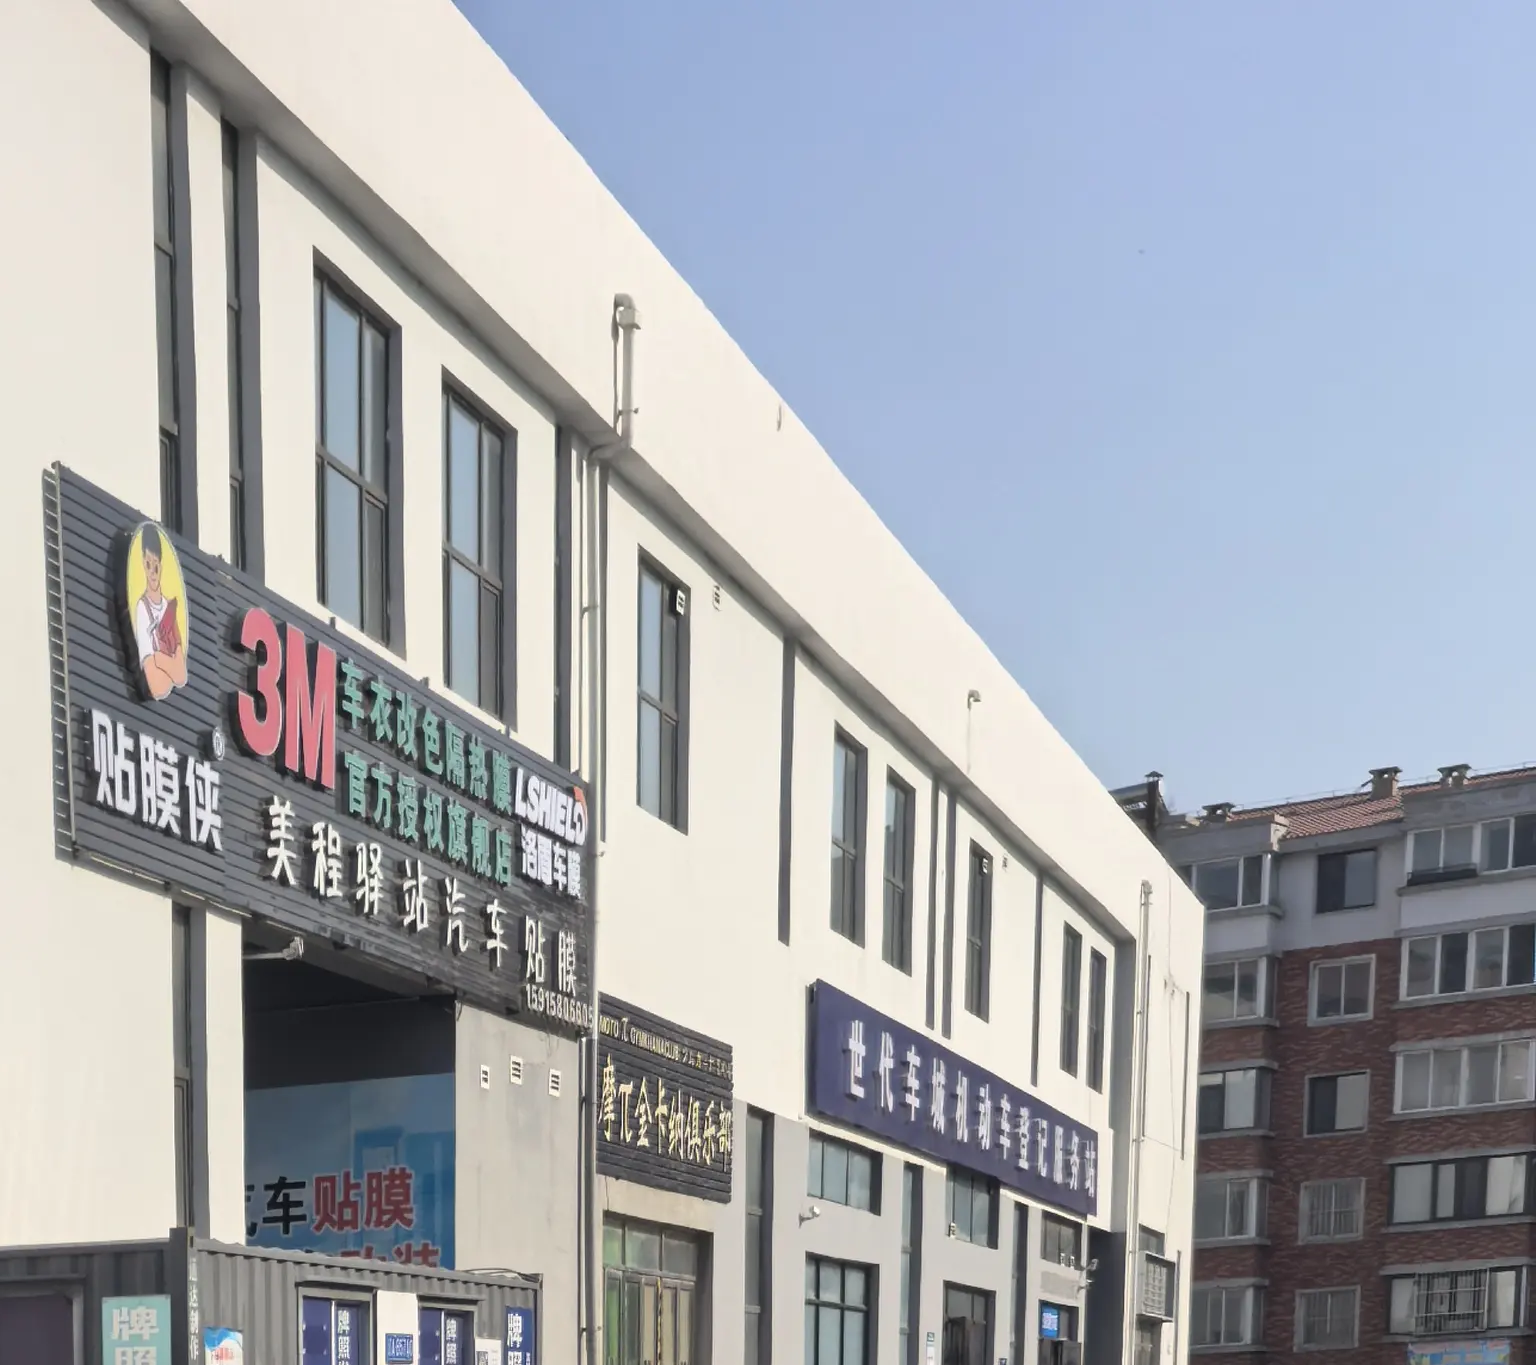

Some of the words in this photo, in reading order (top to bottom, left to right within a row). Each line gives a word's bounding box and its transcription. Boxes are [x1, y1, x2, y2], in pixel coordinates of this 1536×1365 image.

[91, 708, 224, 852] 贴膜侠
[238, 607, 338, 790] 3M
[340, 656, 513, 817] 车衣改色隔热膜
[266, 794, 578, 998] 美程驿站汽车贴膜
[343, 749, 513, 888] 官方授权旗舰店
[848, 1019, 1097, 1199] 世代车城机动车登记服务站
